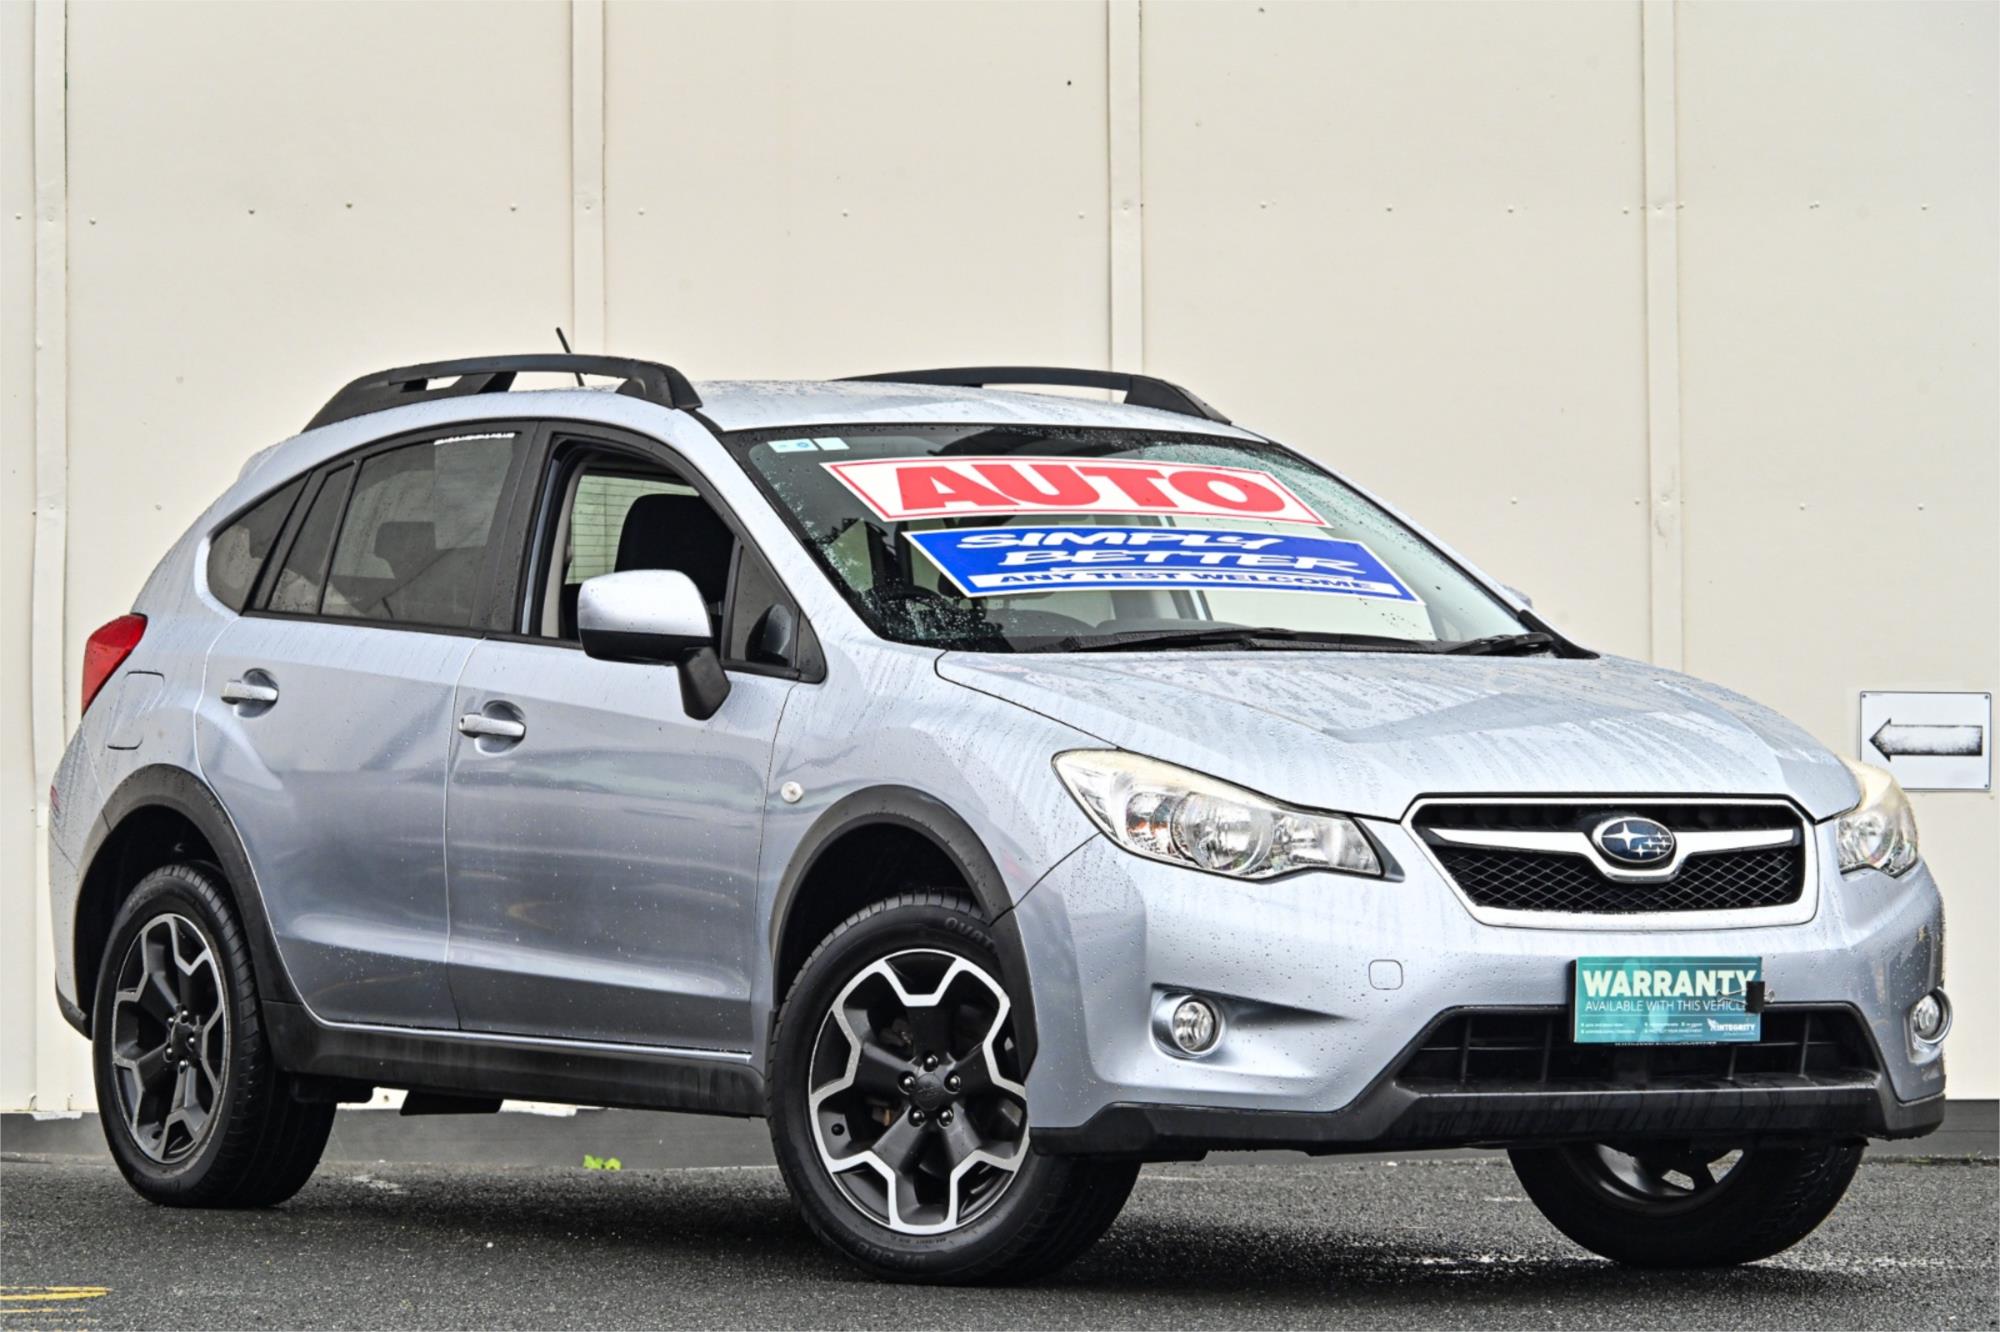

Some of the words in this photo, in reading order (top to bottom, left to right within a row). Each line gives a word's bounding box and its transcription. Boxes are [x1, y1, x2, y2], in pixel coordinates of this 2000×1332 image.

[896, 463, 1286, 512] AUTO
[956, 531, 1284, 550] SIMPLY
[998, 549, 1367, 574] BETTER
[1000, 572, 1076, 583] ANY
[1086, 572, 1180, 580] TEST
[1189, 572, 1376, 590] WELCOME
[1582, 969, 1757, 998] WARRANTY
[1585, 1000, 1643, 1012] AVAILABLE
[1645, 1000, 1674, 1011] WITH
[1677, 1000, 1700, 1011] THIS
